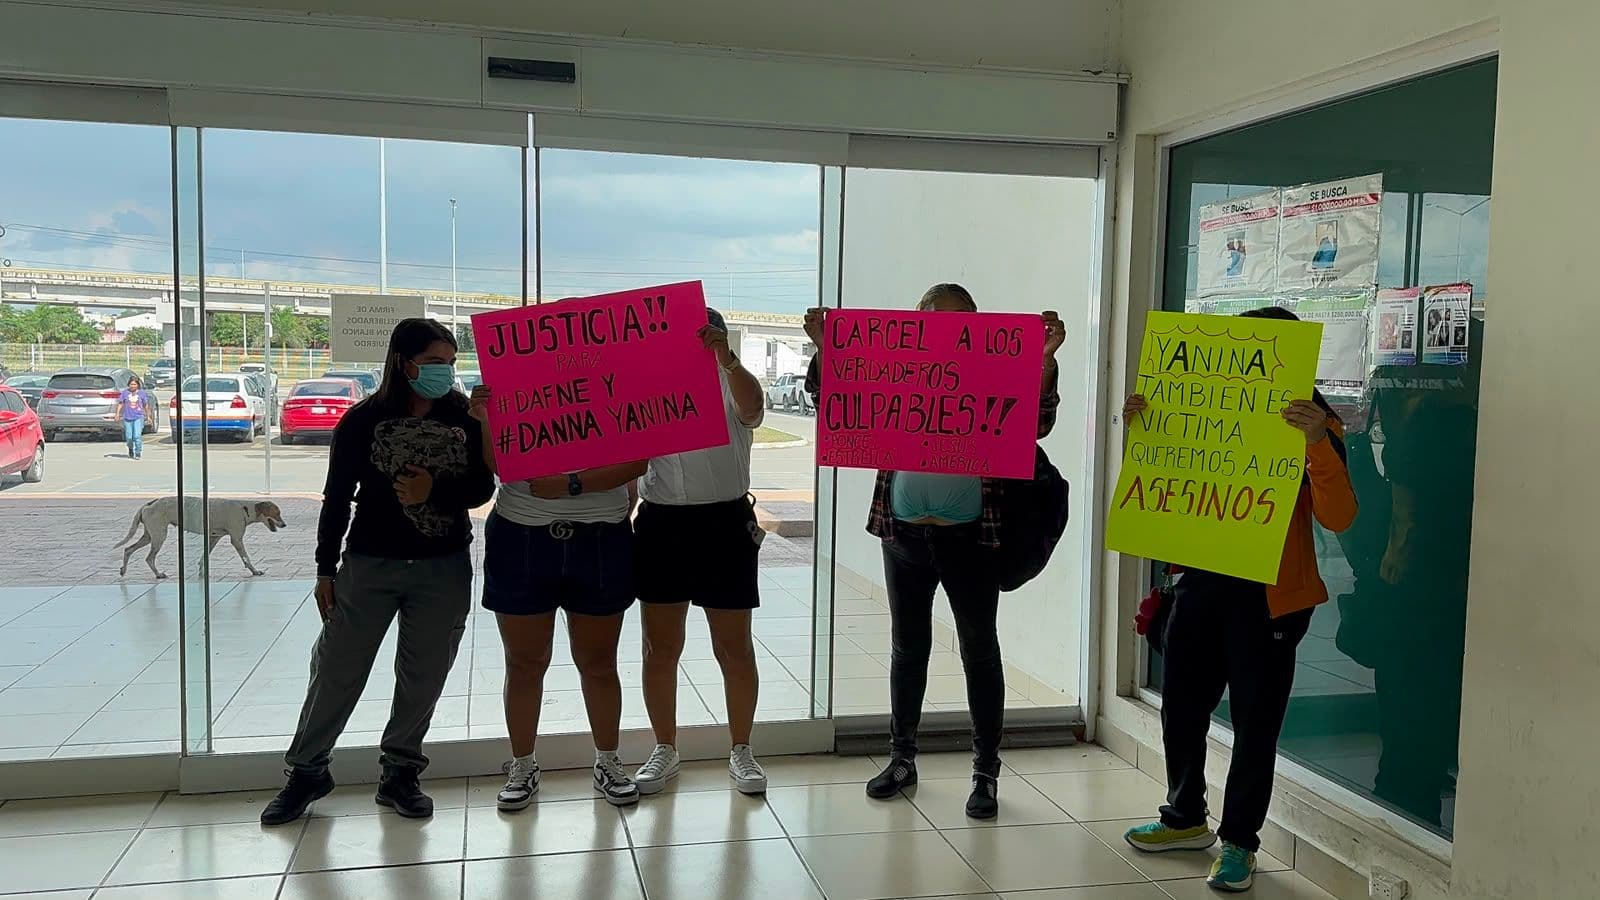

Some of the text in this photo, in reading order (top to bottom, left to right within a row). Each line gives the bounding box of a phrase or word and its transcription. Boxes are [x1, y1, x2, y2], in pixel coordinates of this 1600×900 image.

[1222, 205, 1230, 215] SE
[1310, 186, 1348, 201] SE BUSCA
[488, 295, 668, 358] JUSTICIA!!
[832, 316, 1024, 357] CARCEL A LOS
[556, 350, 604, 373] PARA
[831, 356, 960, 391] VERDADEROS
[1156, 335, 1267, 377] YANINA
[600, 373, 616, 399] Y
[1139, 373, 1293, 415] TAMBIEN ES
[495, 391, 699, 454] #DANNA YANINA
[1137, 409, 1244, 446] VICTIMA
[930, 454, 991, 474] AMERICA
[1131, 441, 1300, 481] QUEREMOS A LOS
[1119, 475, 1277, 525] ASESINOS
